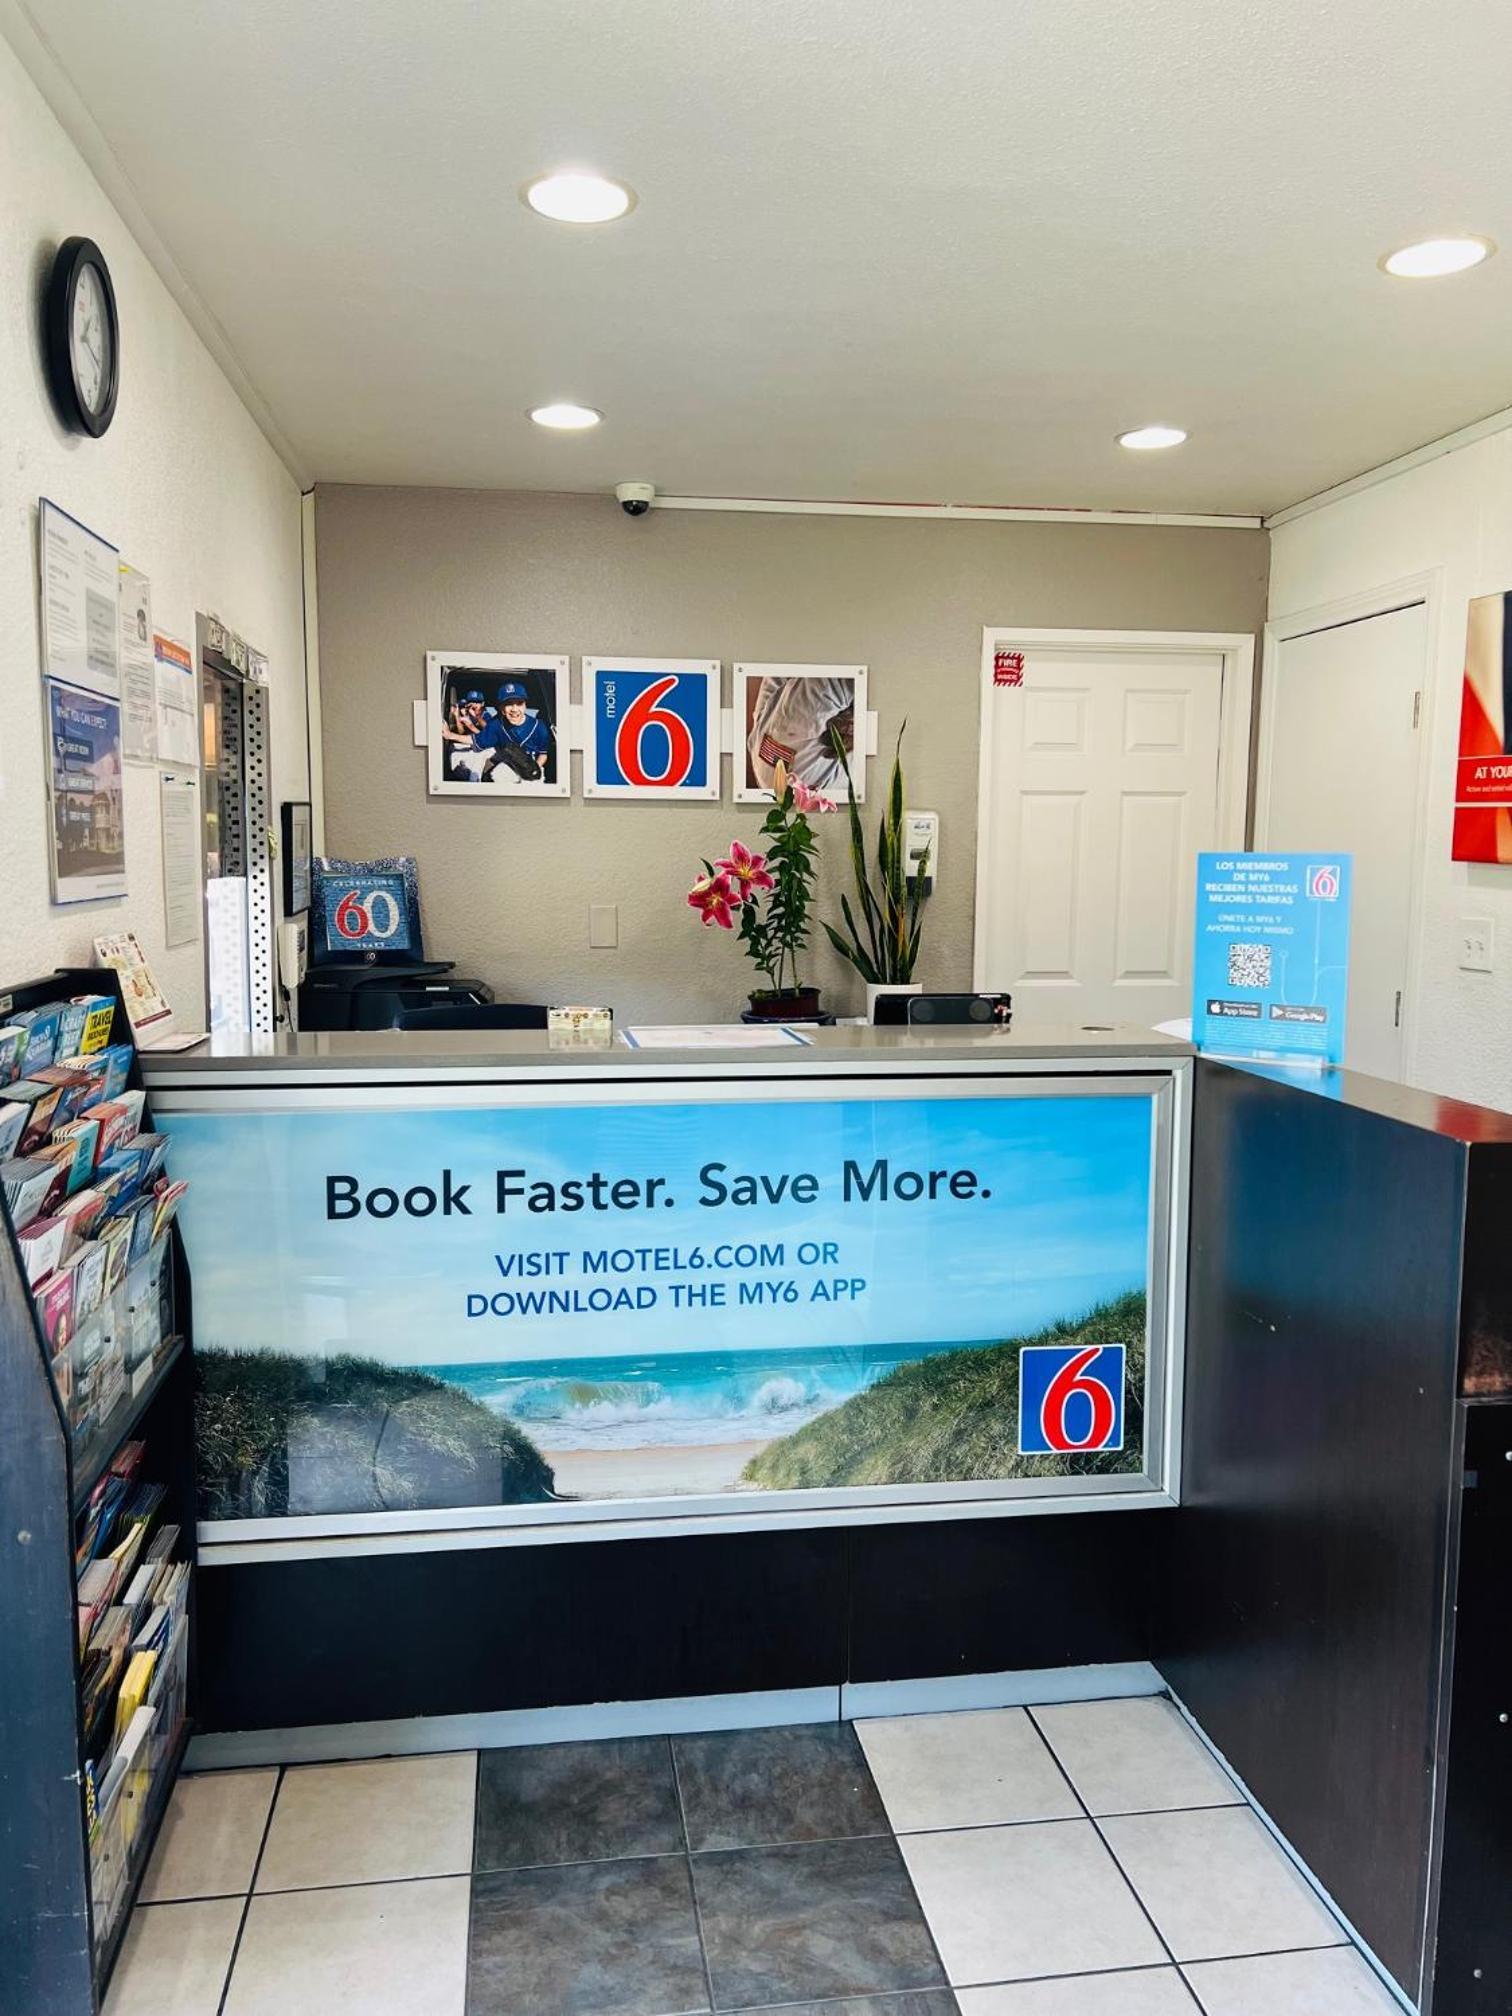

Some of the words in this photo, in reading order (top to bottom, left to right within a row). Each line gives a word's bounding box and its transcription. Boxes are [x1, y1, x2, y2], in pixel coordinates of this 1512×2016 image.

[603, 680, 616, 718] motel
[615, 675, 694, 787] 6
[1474, 766, 1488, 780] AT
[1216, 862, 1234, 871] LOS
[1233, 872, 1246, 881] DE
[335, 890, 399, 939] 60
[326, 1169, 472, 1220] Book
[497, 1170, 674, 1214] Faster.
[699, 1163, 819, 1207] Save
[844, 1160, 991, 1202] More.
[494, 1252, 570, 1277] VISIT
[583, 1243, 784, 1274] MOTEL6.COM
[797, 1242, 839, 1265] OR
[467, 1286, 657, 1317] DOWNLOAD
[668, 1283, 726, 1308] THE
[739, 1280, 799, 1305] MY6
[810, 1278, 866, 1302] APP
[1041, 1345, 1115, 1452] 6
